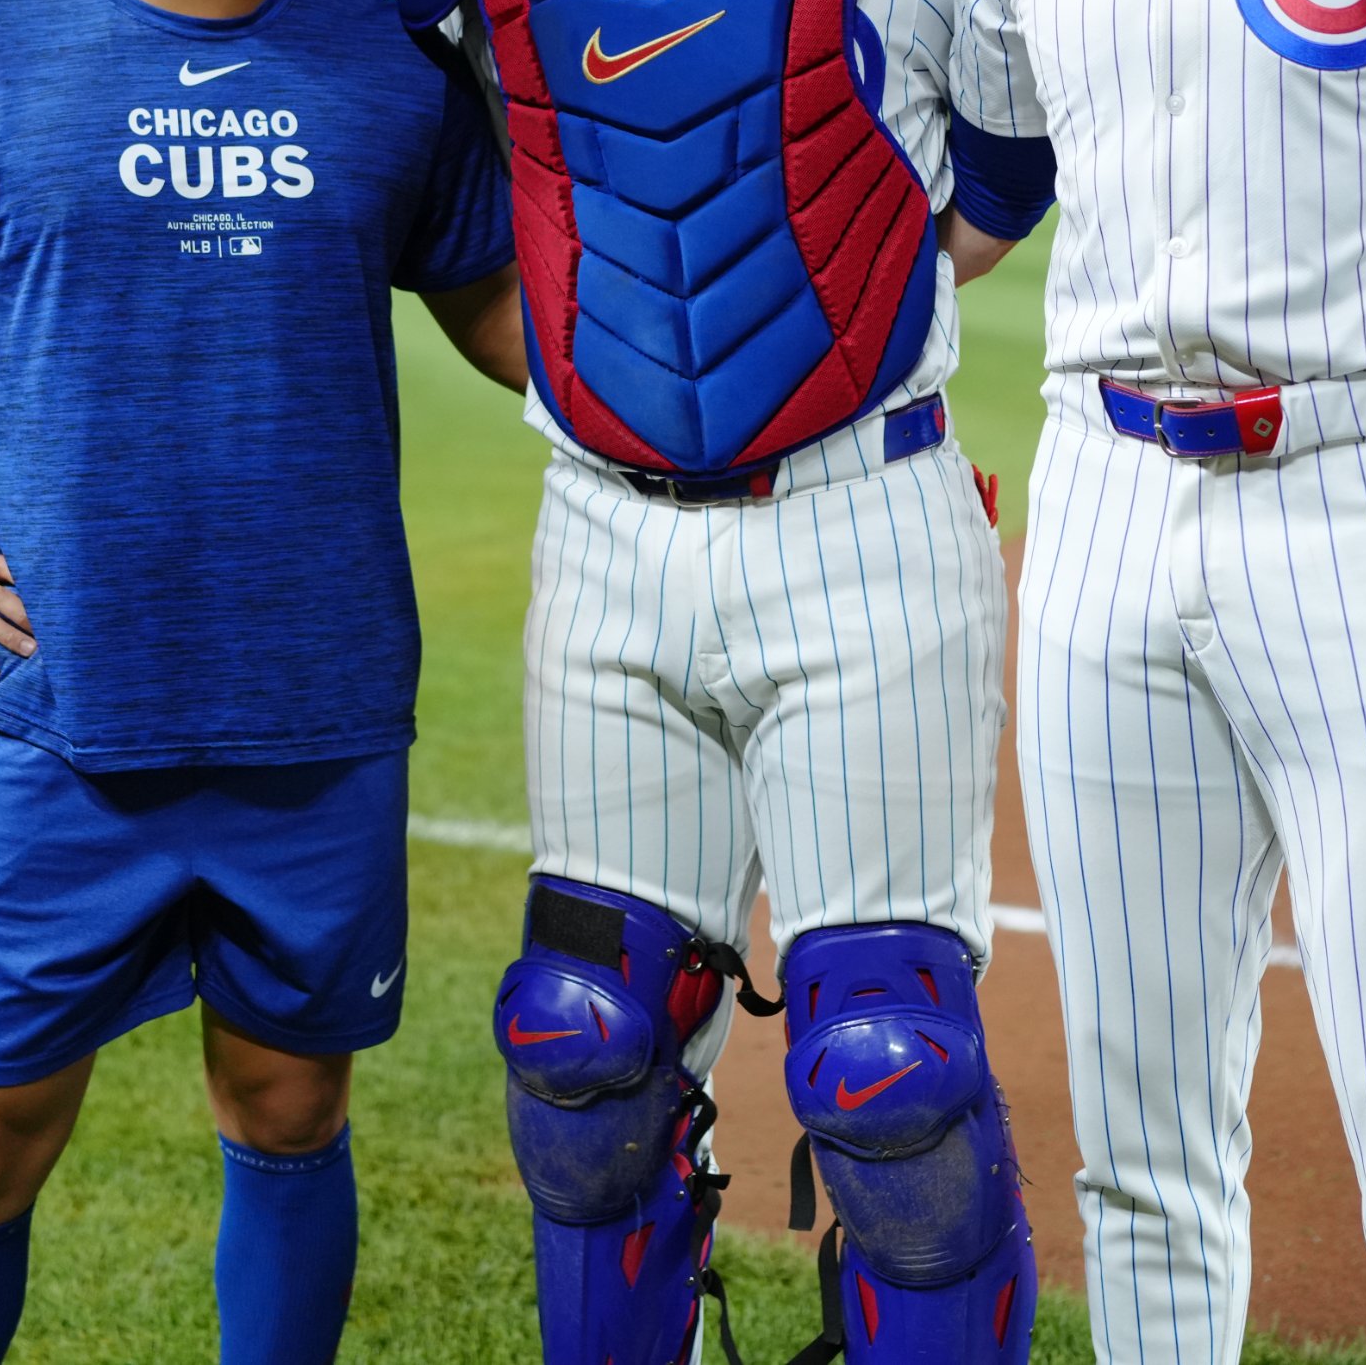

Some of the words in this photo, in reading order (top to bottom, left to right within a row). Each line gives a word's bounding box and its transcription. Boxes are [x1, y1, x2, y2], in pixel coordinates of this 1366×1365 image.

[128, 108, 298, 137] CHICAGO
[119, 143, 314, 199] CUBS
[237, 213, 245, 222] IL
[167, 221, 216, 231] AUTHENTIC
[219, 221, 274, 231] COLLECTION
[180, 240, 211, 254] MLB
